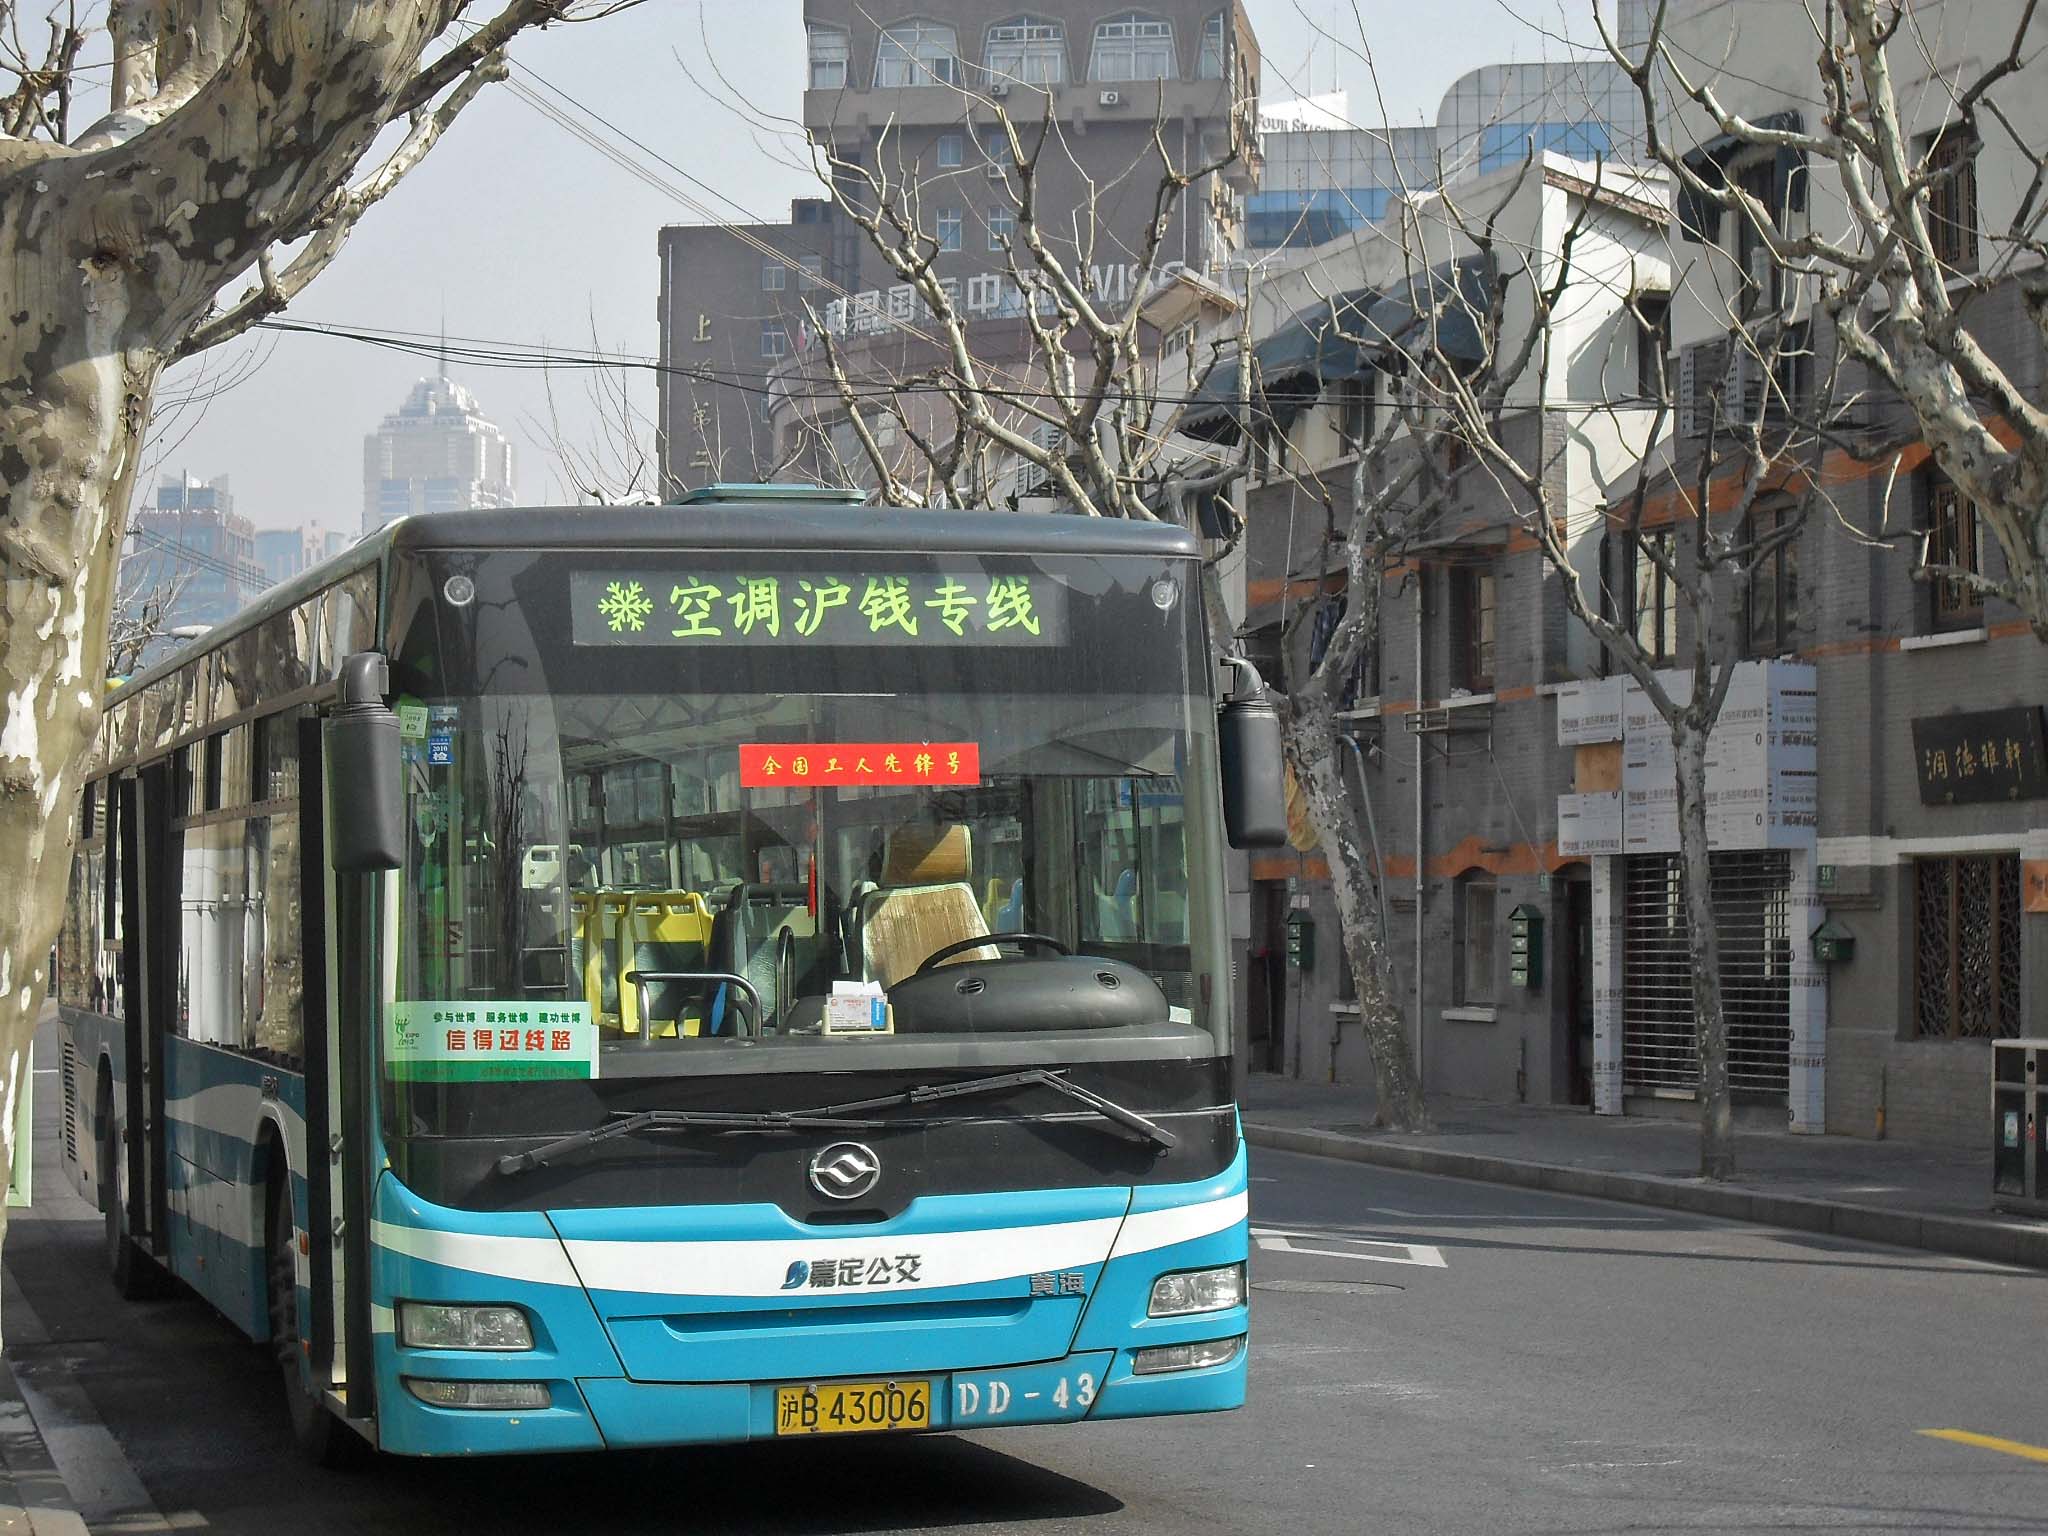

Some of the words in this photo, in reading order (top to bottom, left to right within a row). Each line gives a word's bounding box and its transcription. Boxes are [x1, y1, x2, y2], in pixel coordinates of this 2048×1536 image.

[670, 574, 1041, 638] 空调沪钱专线
[761, 752, 963, 776] 全国工人先锋号
[433, 1012, 476, 1024] 参与世博
[485, 1012, 529, 1024] 服务世博
[446, 1029, 572, 1052] 信得过线路
[808, 1253, 921, 1289] 嘉定公交
[1029, 1272, 1085, 1297] 黄海
